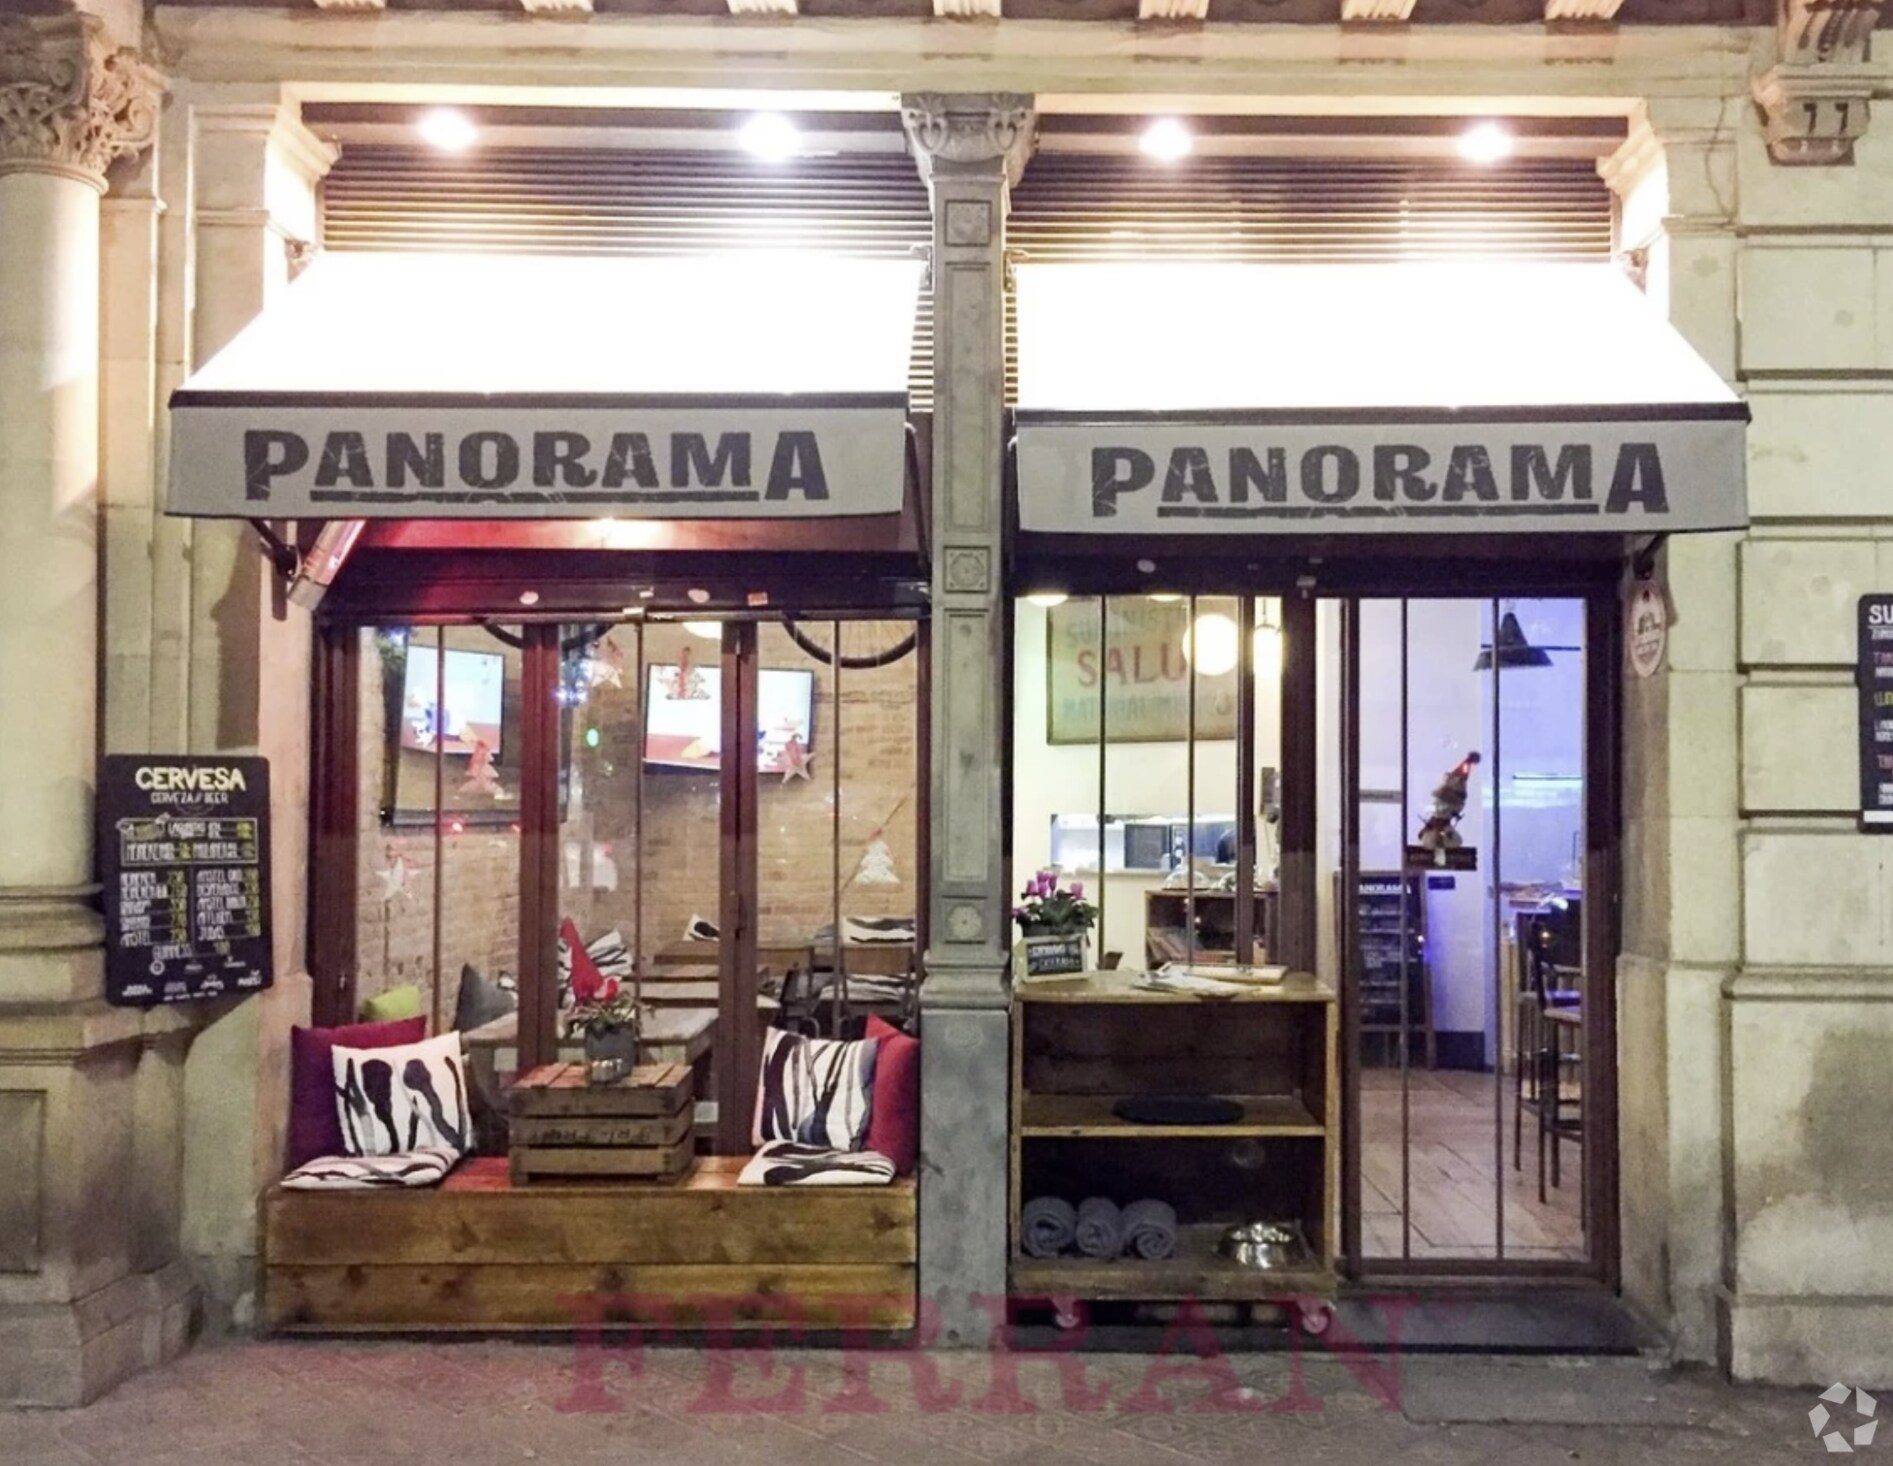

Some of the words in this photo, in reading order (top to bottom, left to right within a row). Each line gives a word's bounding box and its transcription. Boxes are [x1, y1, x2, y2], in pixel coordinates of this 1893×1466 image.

[244, 430, 830, 501] PANORAMA
[1091, 442, 1670, 517] PANORAMA
[1077, 642, 1187, 688] SALU
[135, 766, 247, 791] CERVESA
[204, 792, 229, 804] BEER
